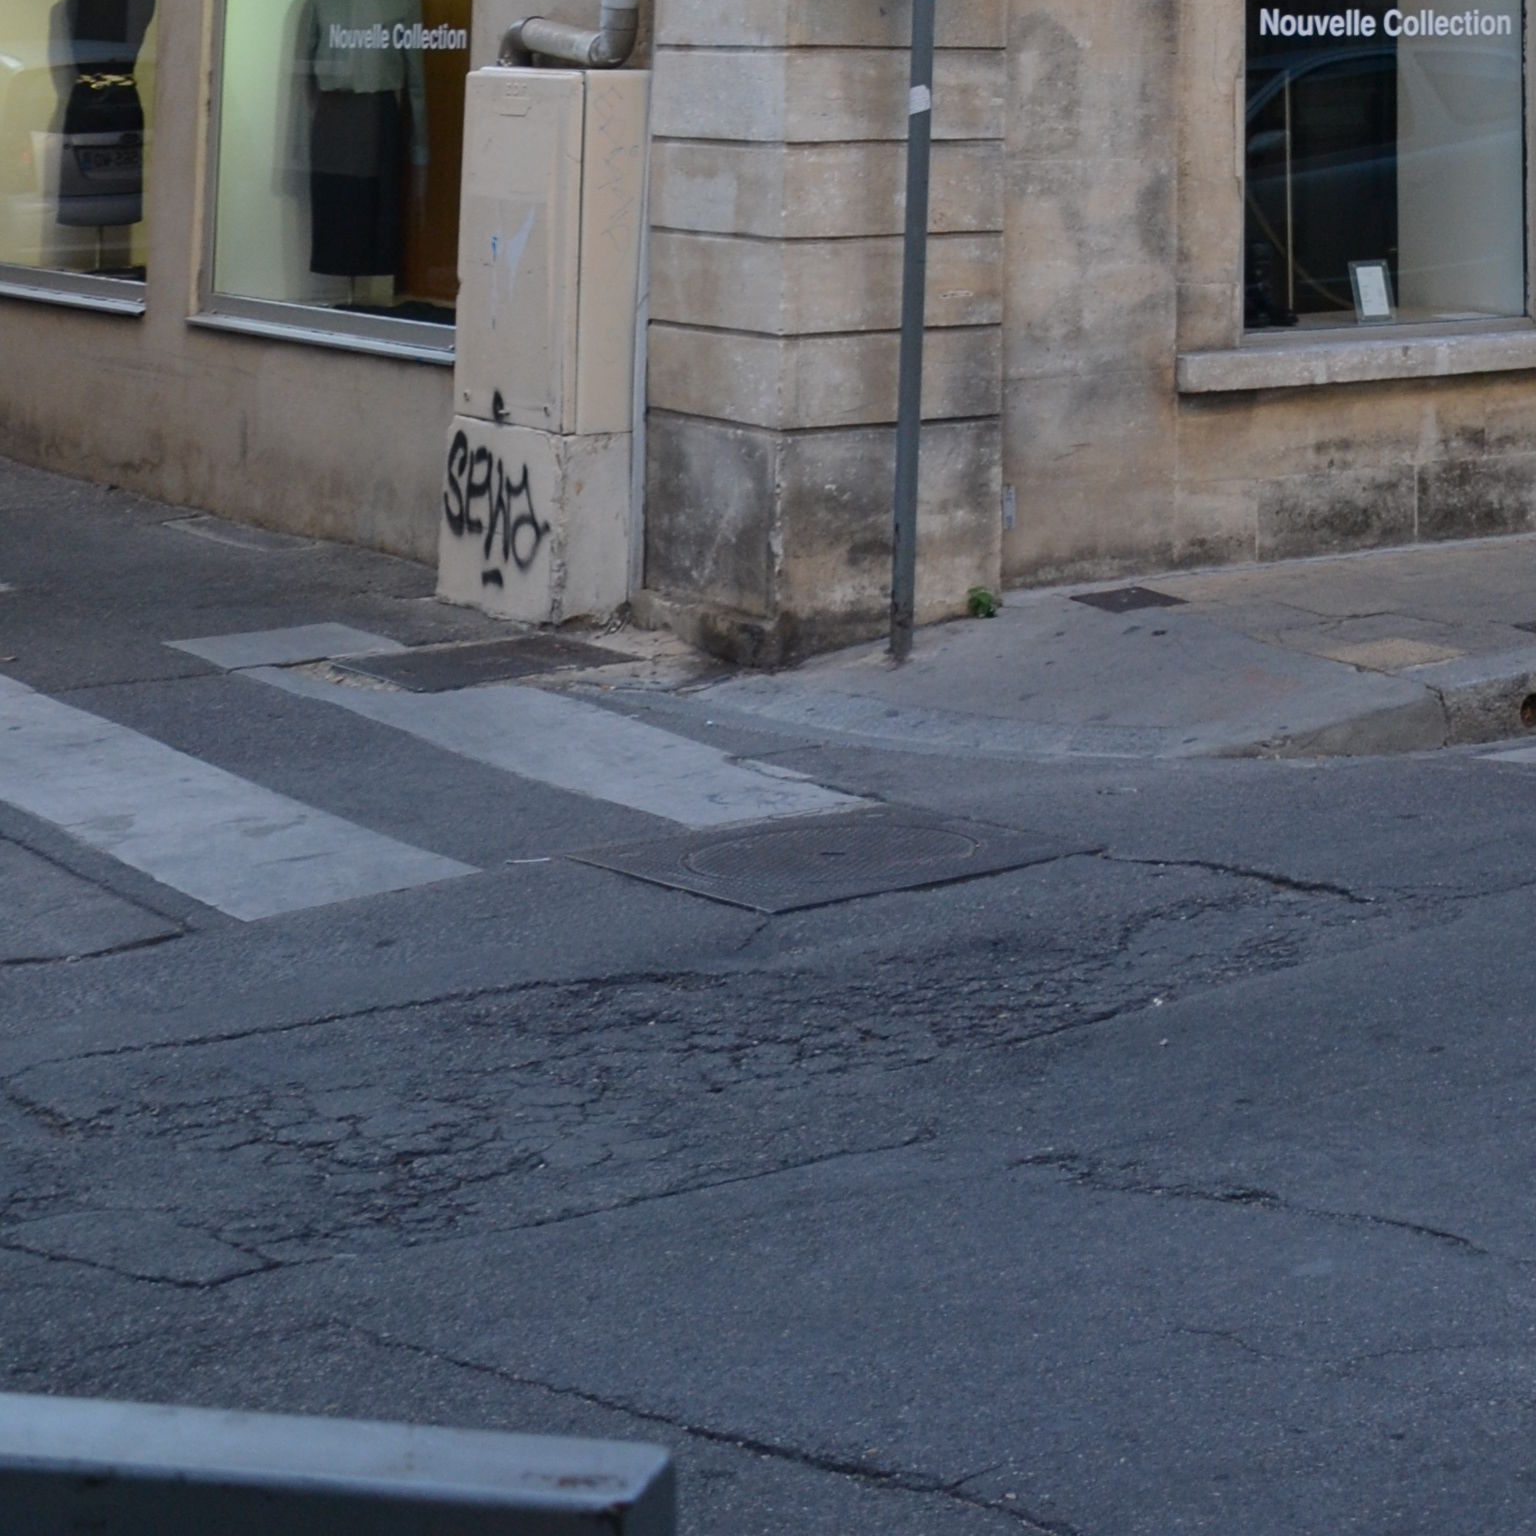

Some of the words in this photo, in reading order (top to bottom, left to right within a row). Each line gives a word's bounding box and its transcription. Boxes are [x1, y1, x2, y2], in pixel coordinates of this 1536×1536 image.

[329, 23, 390, 49] Nouvelle
[392, 23, 468, 49] Collection
[1259, 8, 1377, 37] Nouvelle
[1383, 8, 1512, 37] Collection
